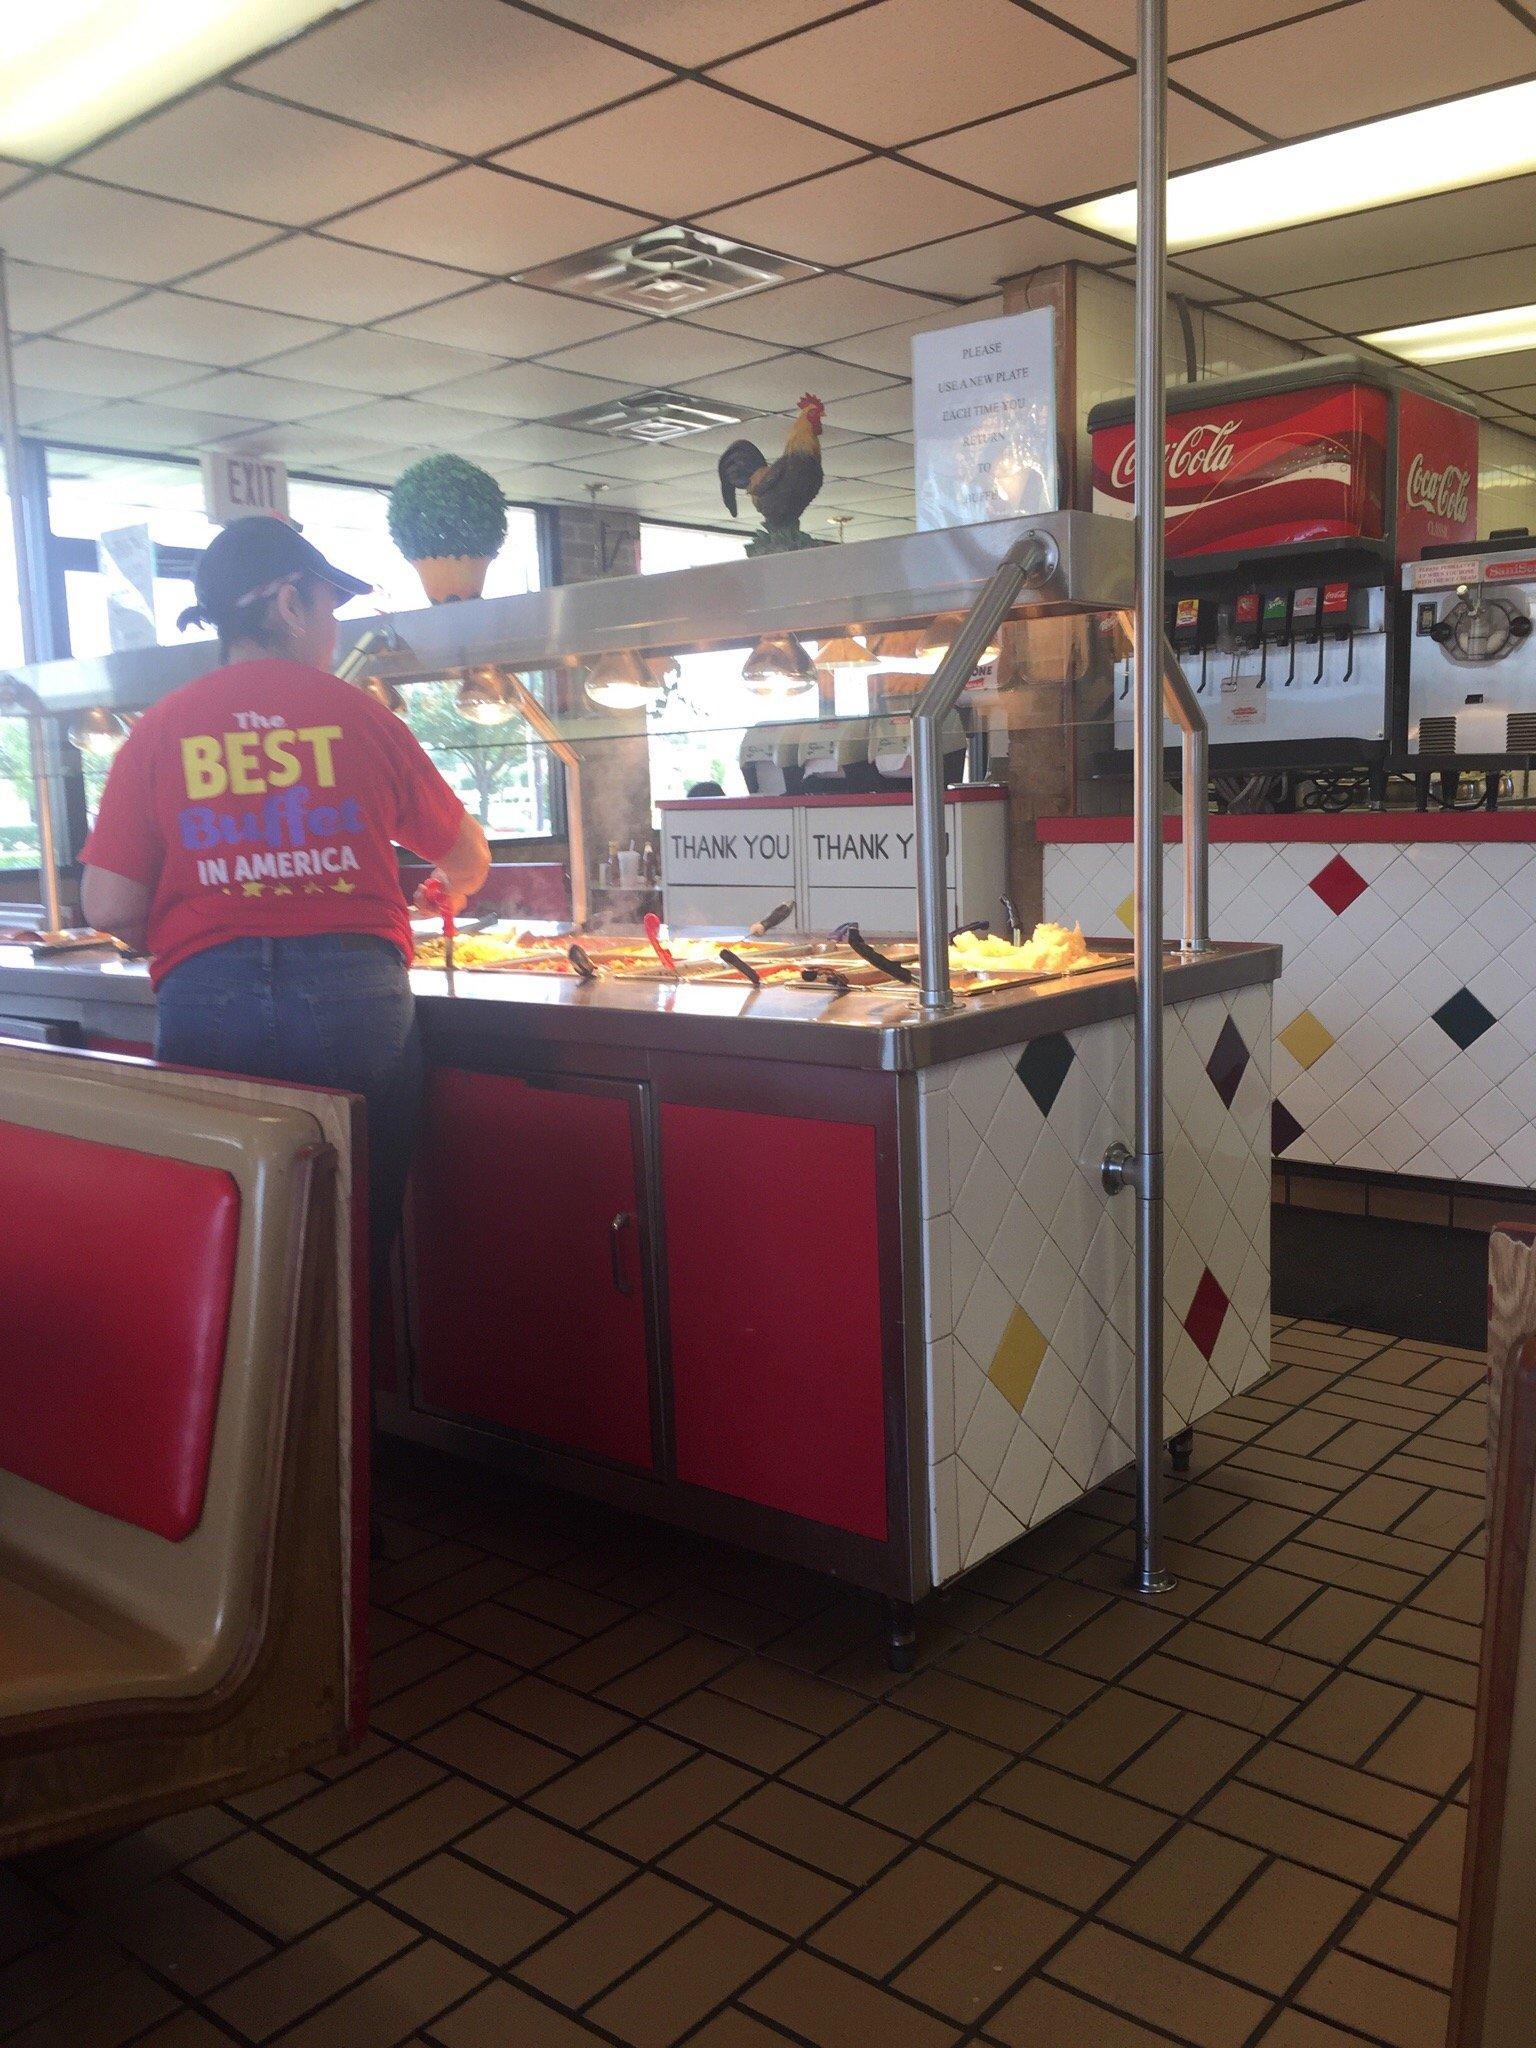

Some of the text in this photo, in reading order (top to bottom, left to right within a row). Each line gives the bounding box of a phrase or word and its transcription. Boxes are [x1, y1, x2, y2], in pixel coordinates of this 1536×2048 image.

[962, 342, 1002, 360] PLEASE
[938, 367, 1029, 393] USE A NEW PLATE
[942, 398, 1026, 422] EACH TIME YOU
[1111, 419, 1243, 489] Co-Cola
[227, 459, 276, 508] EXIT
[1406, 453, 1471, 523] Coca-Cola
[231, 711, 286, 730] The
[180, 725, 344, 800] BEST
[178, 786, 367, 850] Buffet
[671, 833, 790, 860] THANK YOU
[813, 832, 889, 860] THANK
[197, 845, 361, 886] IN AMERICA
